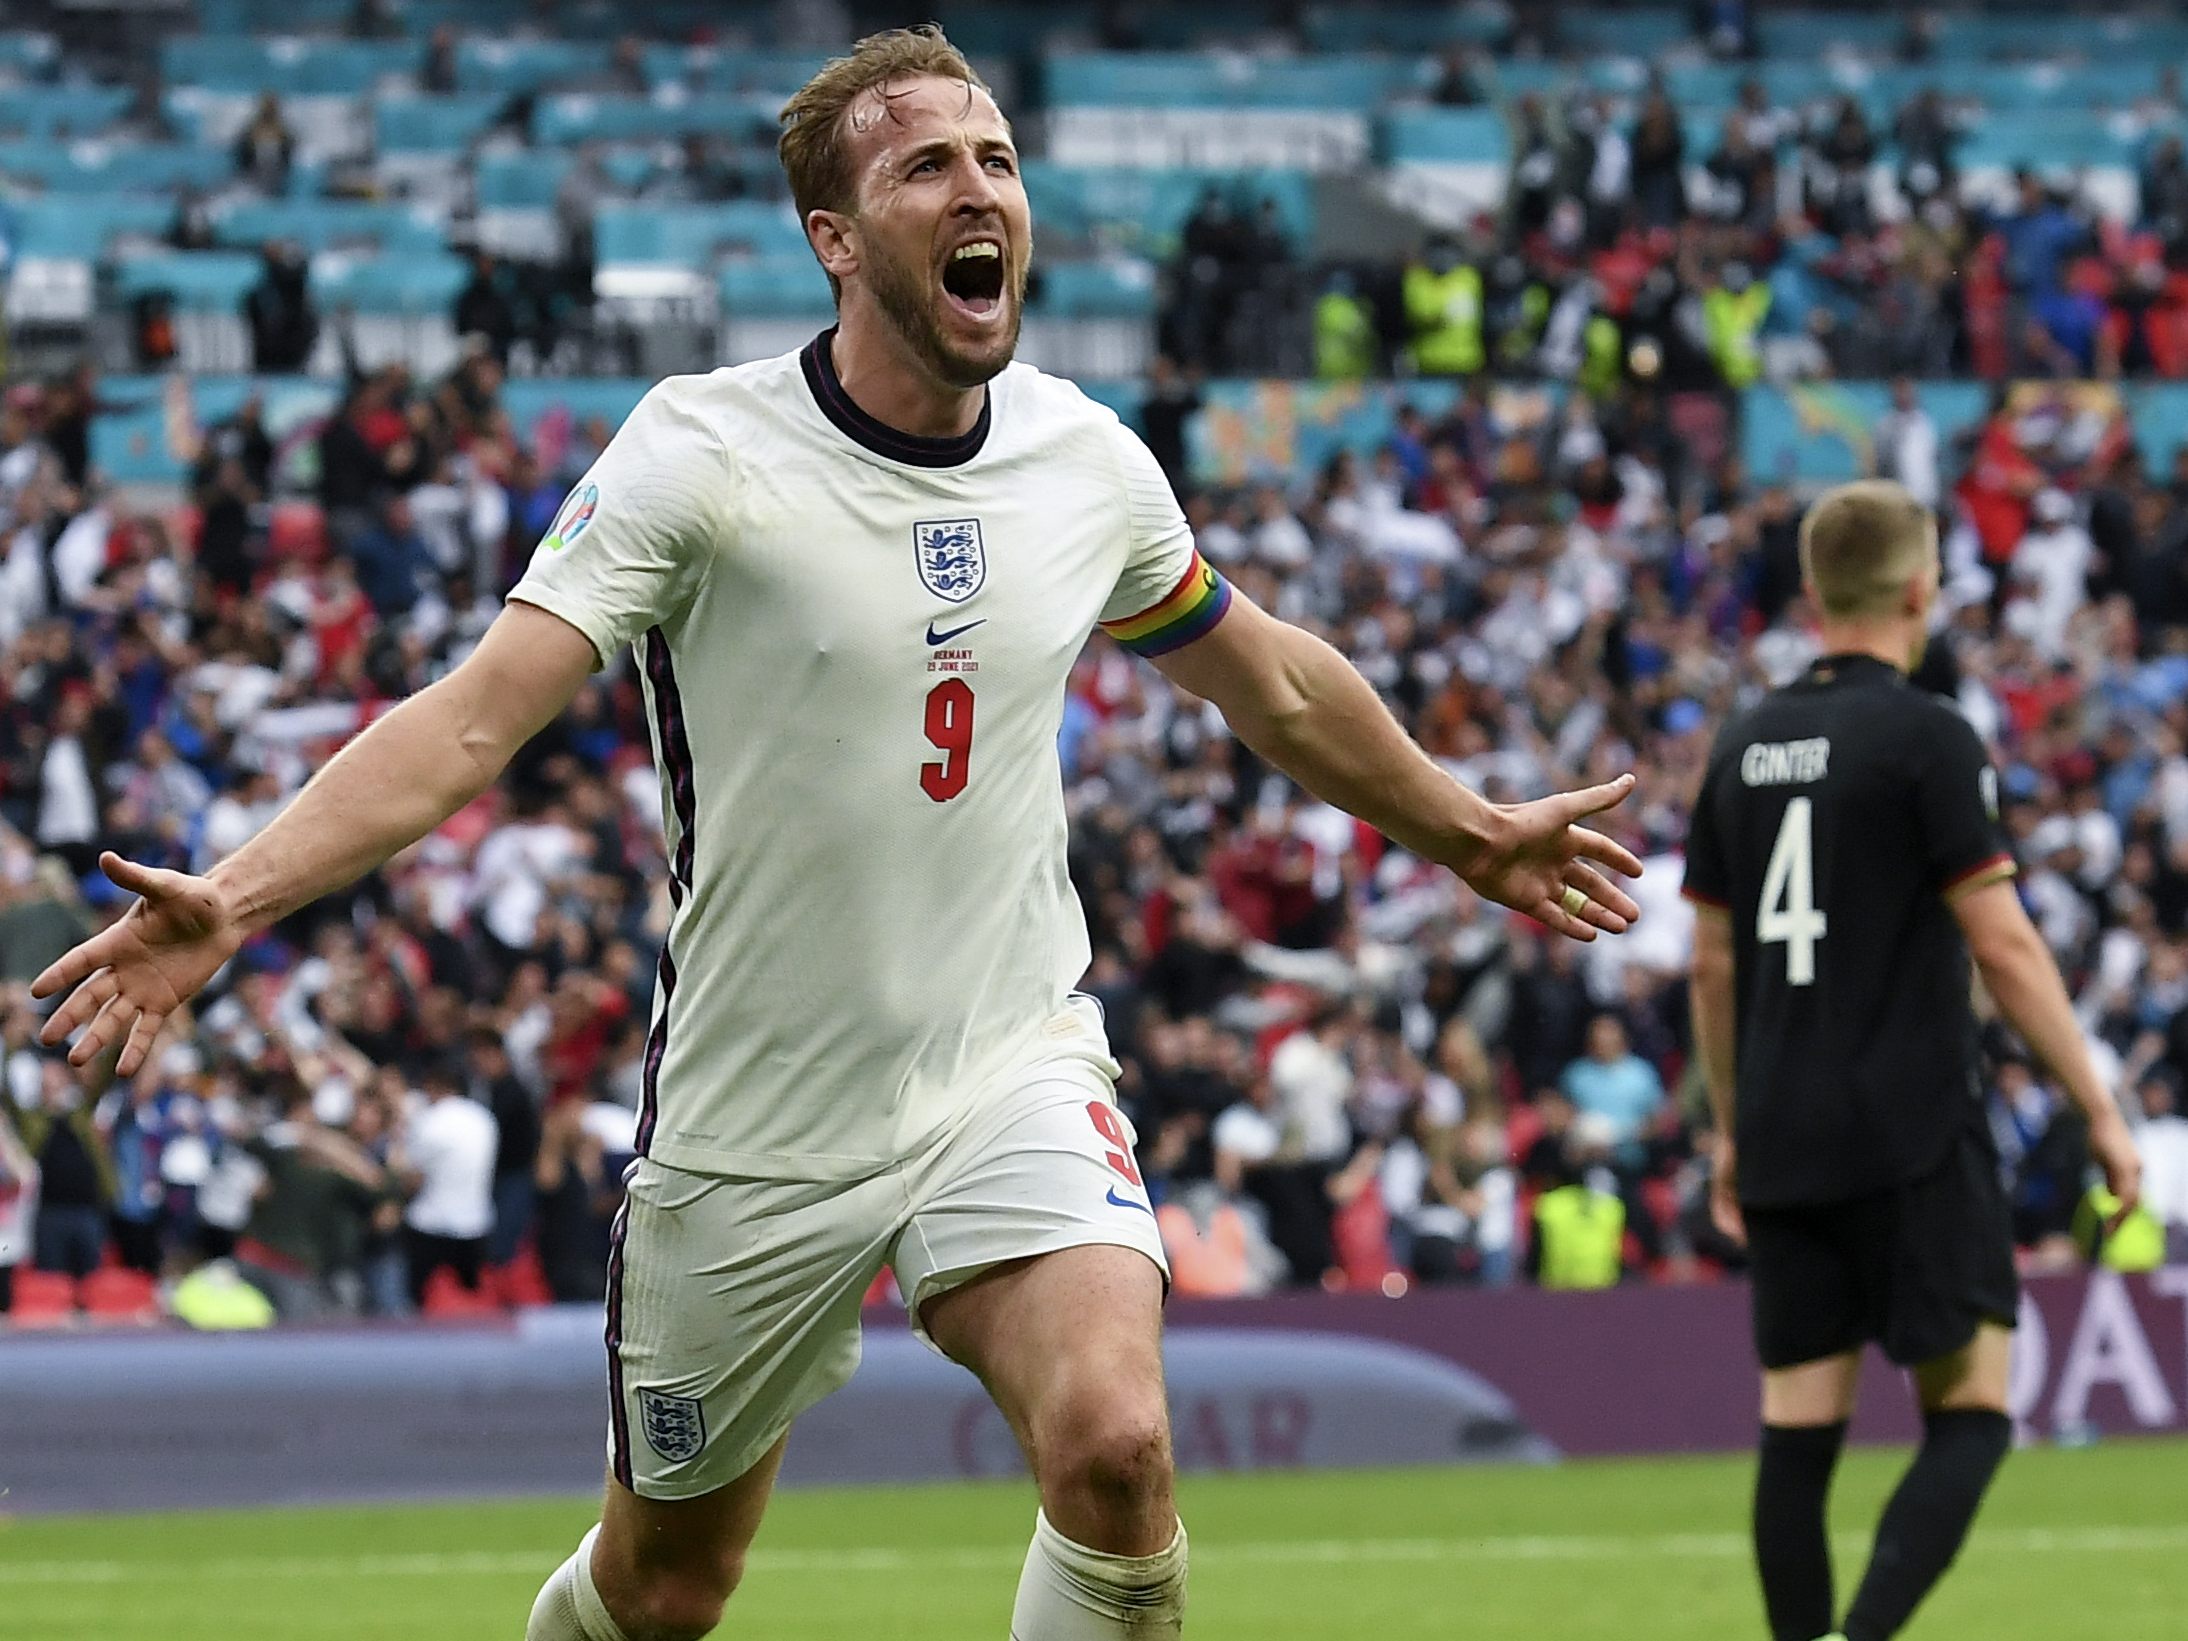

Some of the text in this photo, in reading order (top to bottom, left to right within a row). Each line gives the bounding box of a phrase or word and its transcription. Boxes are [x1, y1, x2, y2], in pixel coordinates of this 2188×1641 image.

[933, 649, 973, 660] GERMANY
[938, 661, 959, 672] JUNE
[961, 661, 979, 672] 2021
[919, 677, 975, 803] 9
[1740, 736, 1831, 787] GINTER
[1756, 796, 1828, 985] 4
[1085, 1100, 1141, 1187] 9
